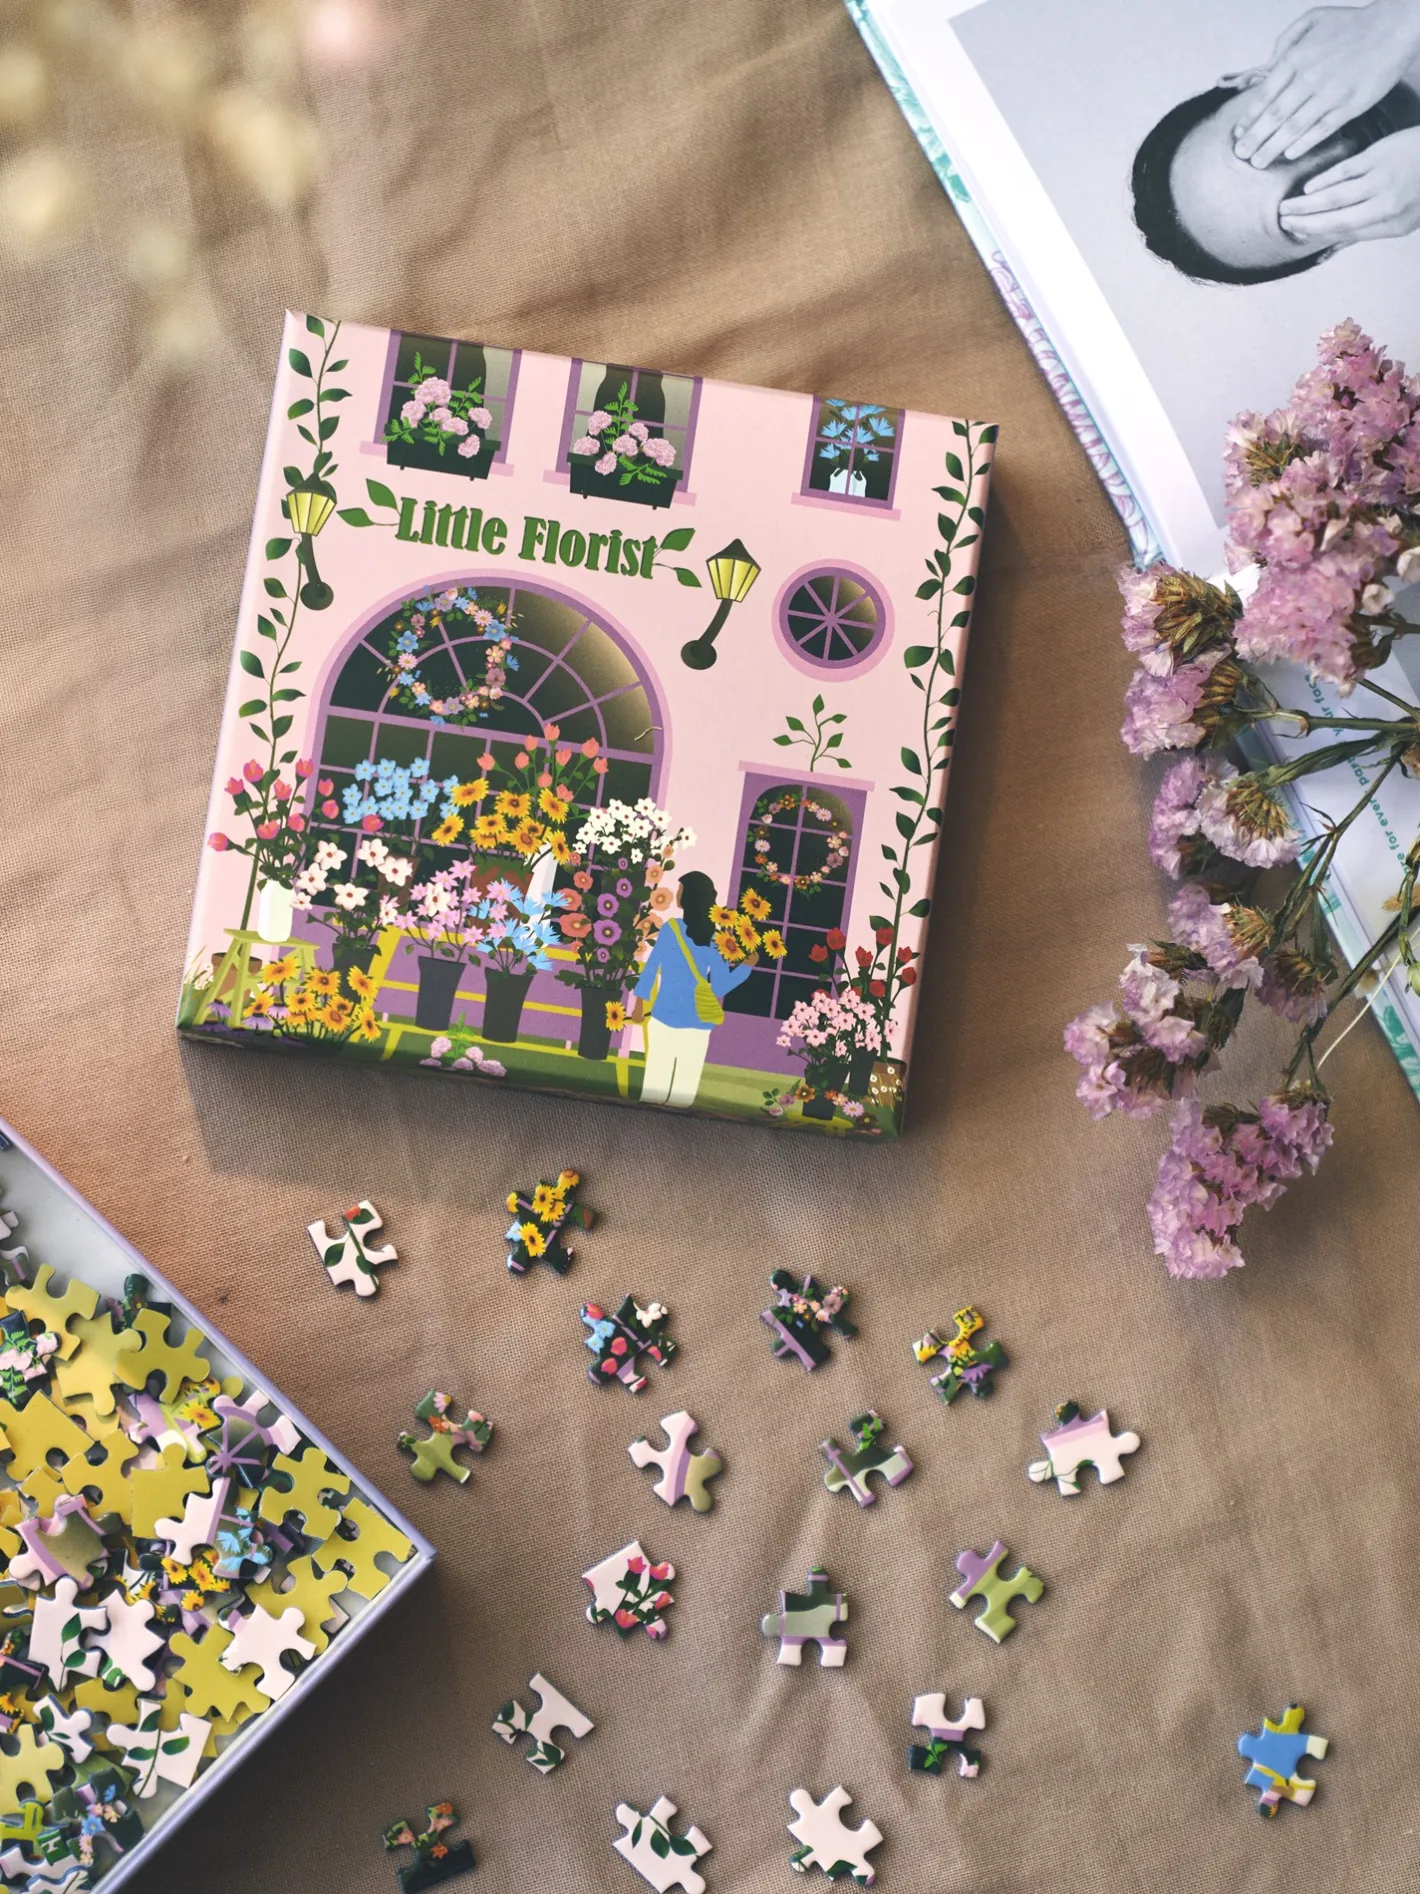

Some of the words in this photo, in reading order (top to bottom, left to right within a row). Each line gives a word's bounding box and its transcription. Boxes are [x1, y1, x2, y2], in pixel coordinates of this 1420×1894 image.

[395, 497, 508, 555] Little
[518, 516, 658, 579] Florist
[1321, 706, 1344, 737] yur
[1347, 757, 1369, 786] part
[1364, 789, 1388, 827] ever
[1385, 830, 1400, 850] for
